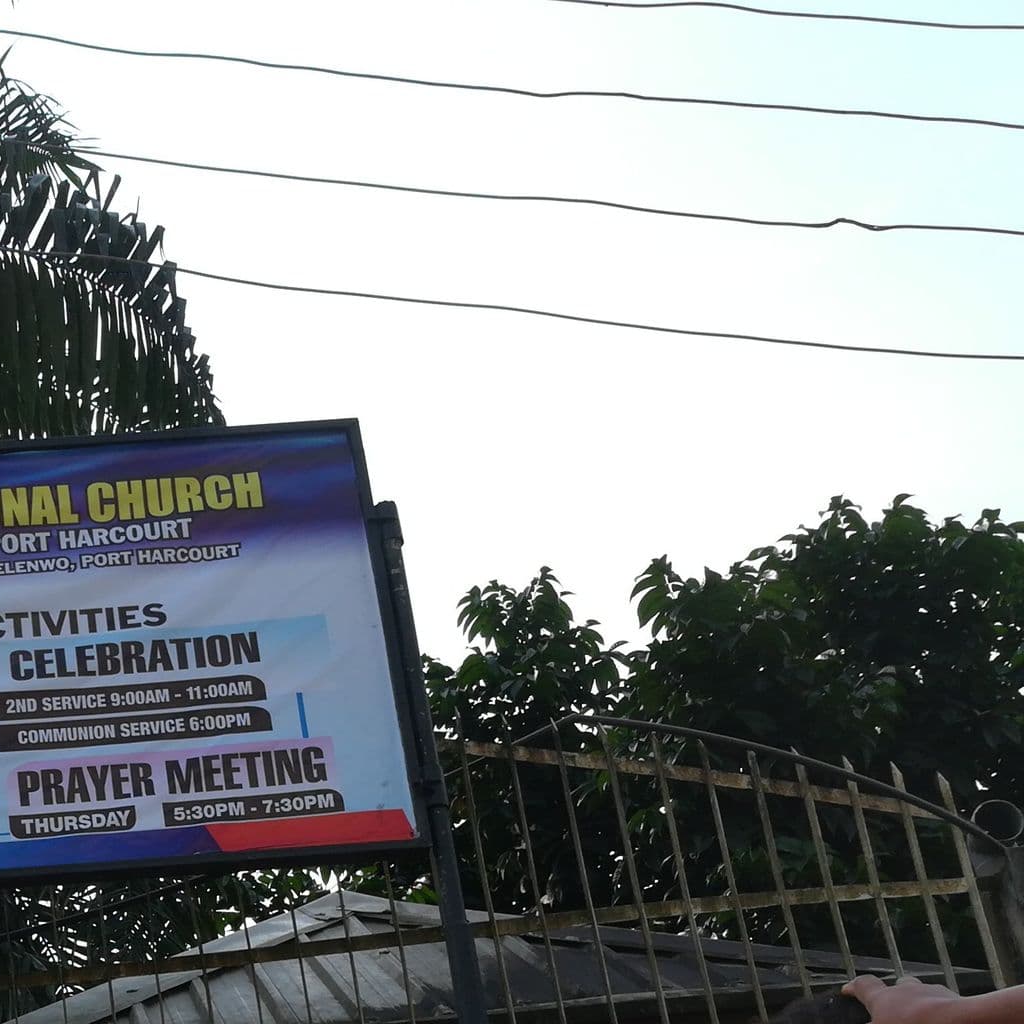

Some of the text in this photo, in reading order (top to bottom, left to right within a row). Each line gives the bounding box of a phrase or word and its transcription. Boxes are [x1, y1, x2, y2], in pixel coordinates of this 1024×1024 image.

[86, 472, 264, 522] CHURCH
[60, 518, 192, 549] HARCOURT
[81, 551, 132, 568] PORT
[138, 544, 240, 564] HARCOURT
[10, 631, 261, 681] CELEBRATION
[6, 698, 38, 714] 2ND
[42, 694, 107, 712] SERVICE
[110, 688, 171, 707] 9:00AM
[185, 681, 253, 701] 11:00AM
[17, 712, 251, 745] COMMUNION SERVICE 6:00PM
[17, 746, 328, 807] PRAYER MEETING
[21, 809, 131, 835] THURSDAY
[173, 800, 245, 821] 5:30PM
[262, 793, 335, 815] 7:30PM
